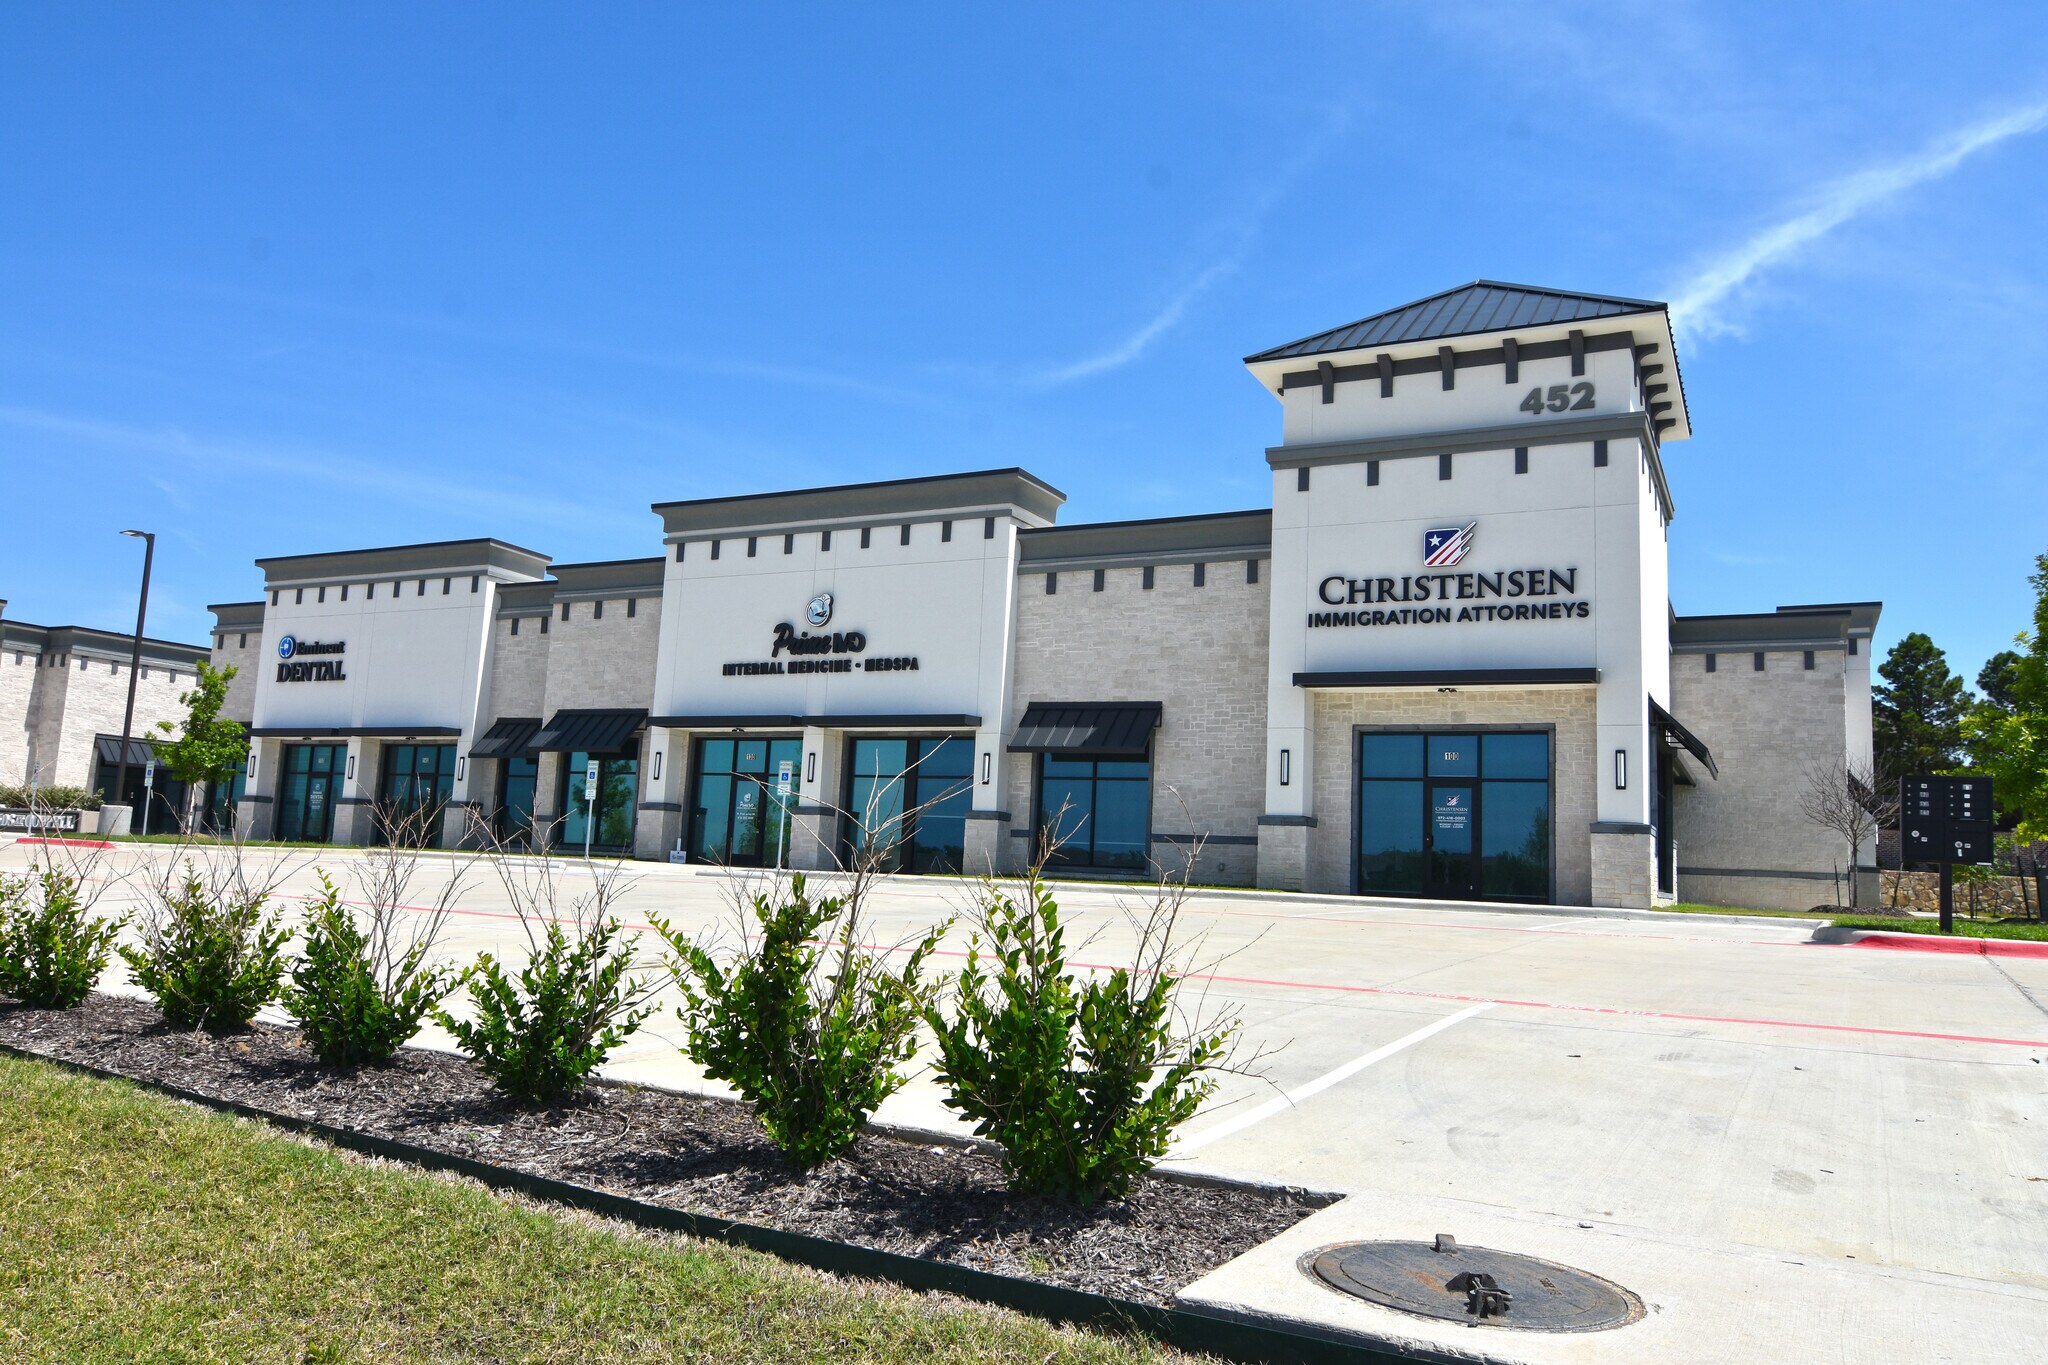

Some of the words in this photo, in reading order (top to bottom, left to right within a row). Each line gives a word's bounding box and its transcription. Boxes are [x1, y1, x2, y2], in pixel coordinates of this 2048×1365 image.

[1520, 382, 1595, 414] 452
[1318, 568, 1577, 605] CHRISTENSEN
[1308, 607, 1451, 628] IMMIGRATION
[1456, 601, 1590, 623] ATTORNEYS
[771, 622, 832, 658] Prime
[276, 661, 346, 682] DENTAL
[722, 661, 785, 677] INTERNAL
[787, 659, 852, 675] MEDICINE
[864, 656, 920, 672] MEDSPA
